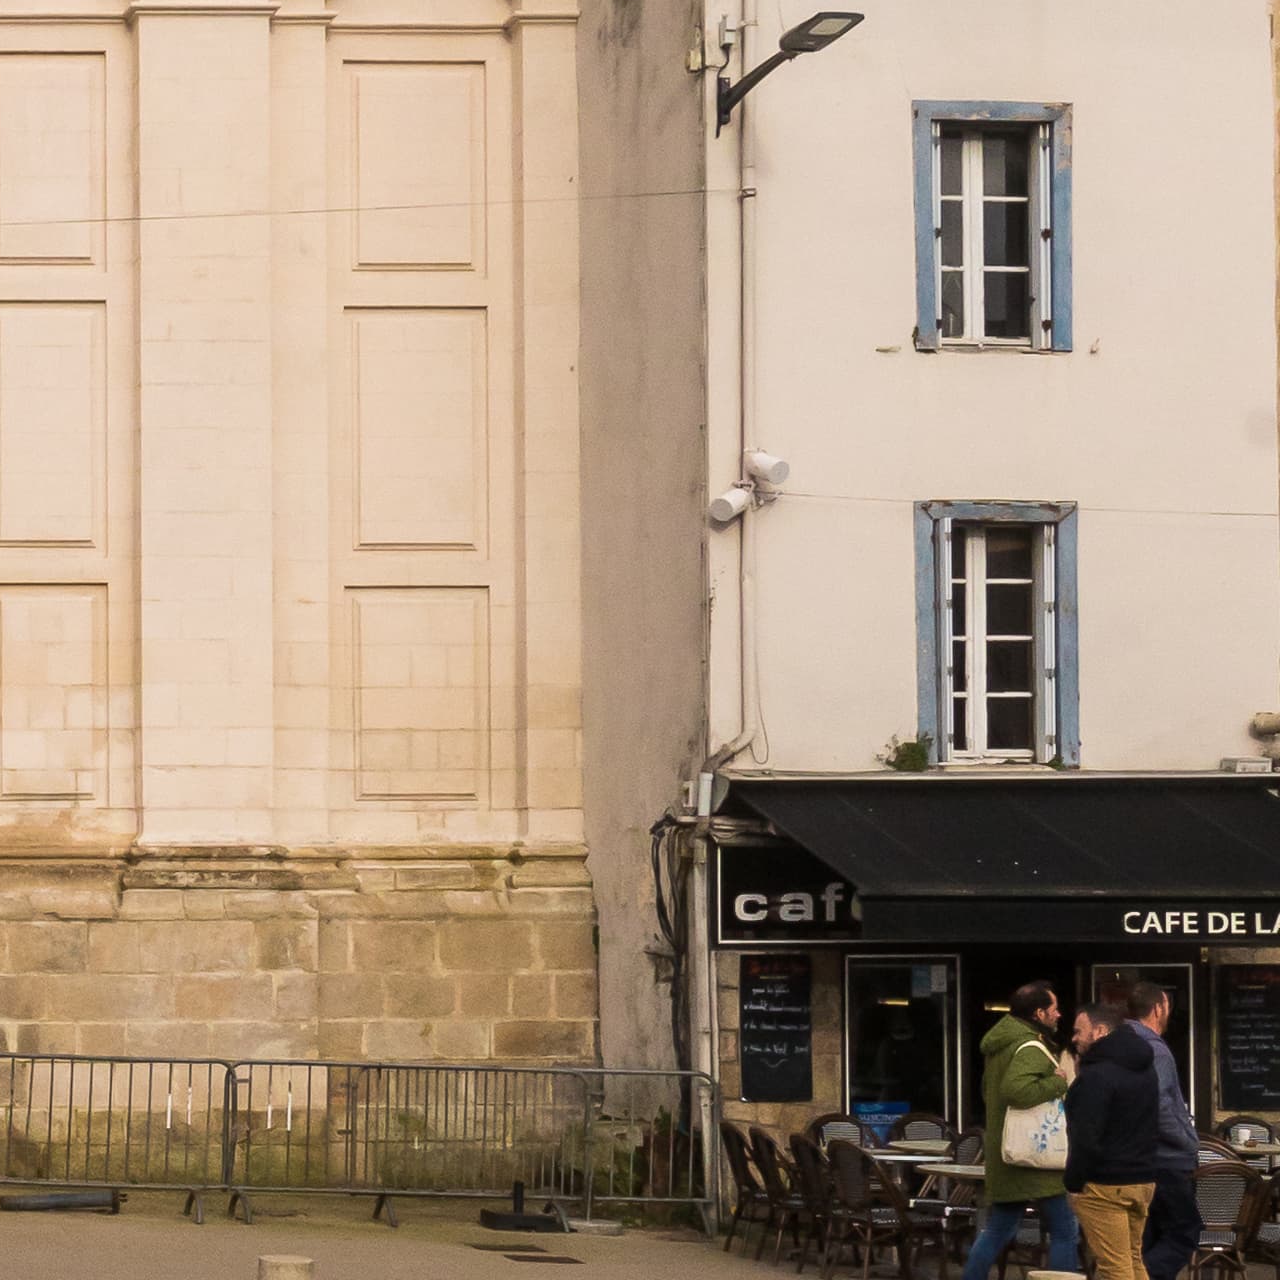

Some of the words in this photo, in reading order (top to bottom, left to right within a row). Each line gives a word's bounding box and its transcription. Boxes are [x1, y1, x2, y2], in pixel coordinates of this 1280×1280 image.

[734, 882, 863, 922] caf
[1123, 911, 1200, 934] CAFE
[1207, 911, 1247, 934] DE
